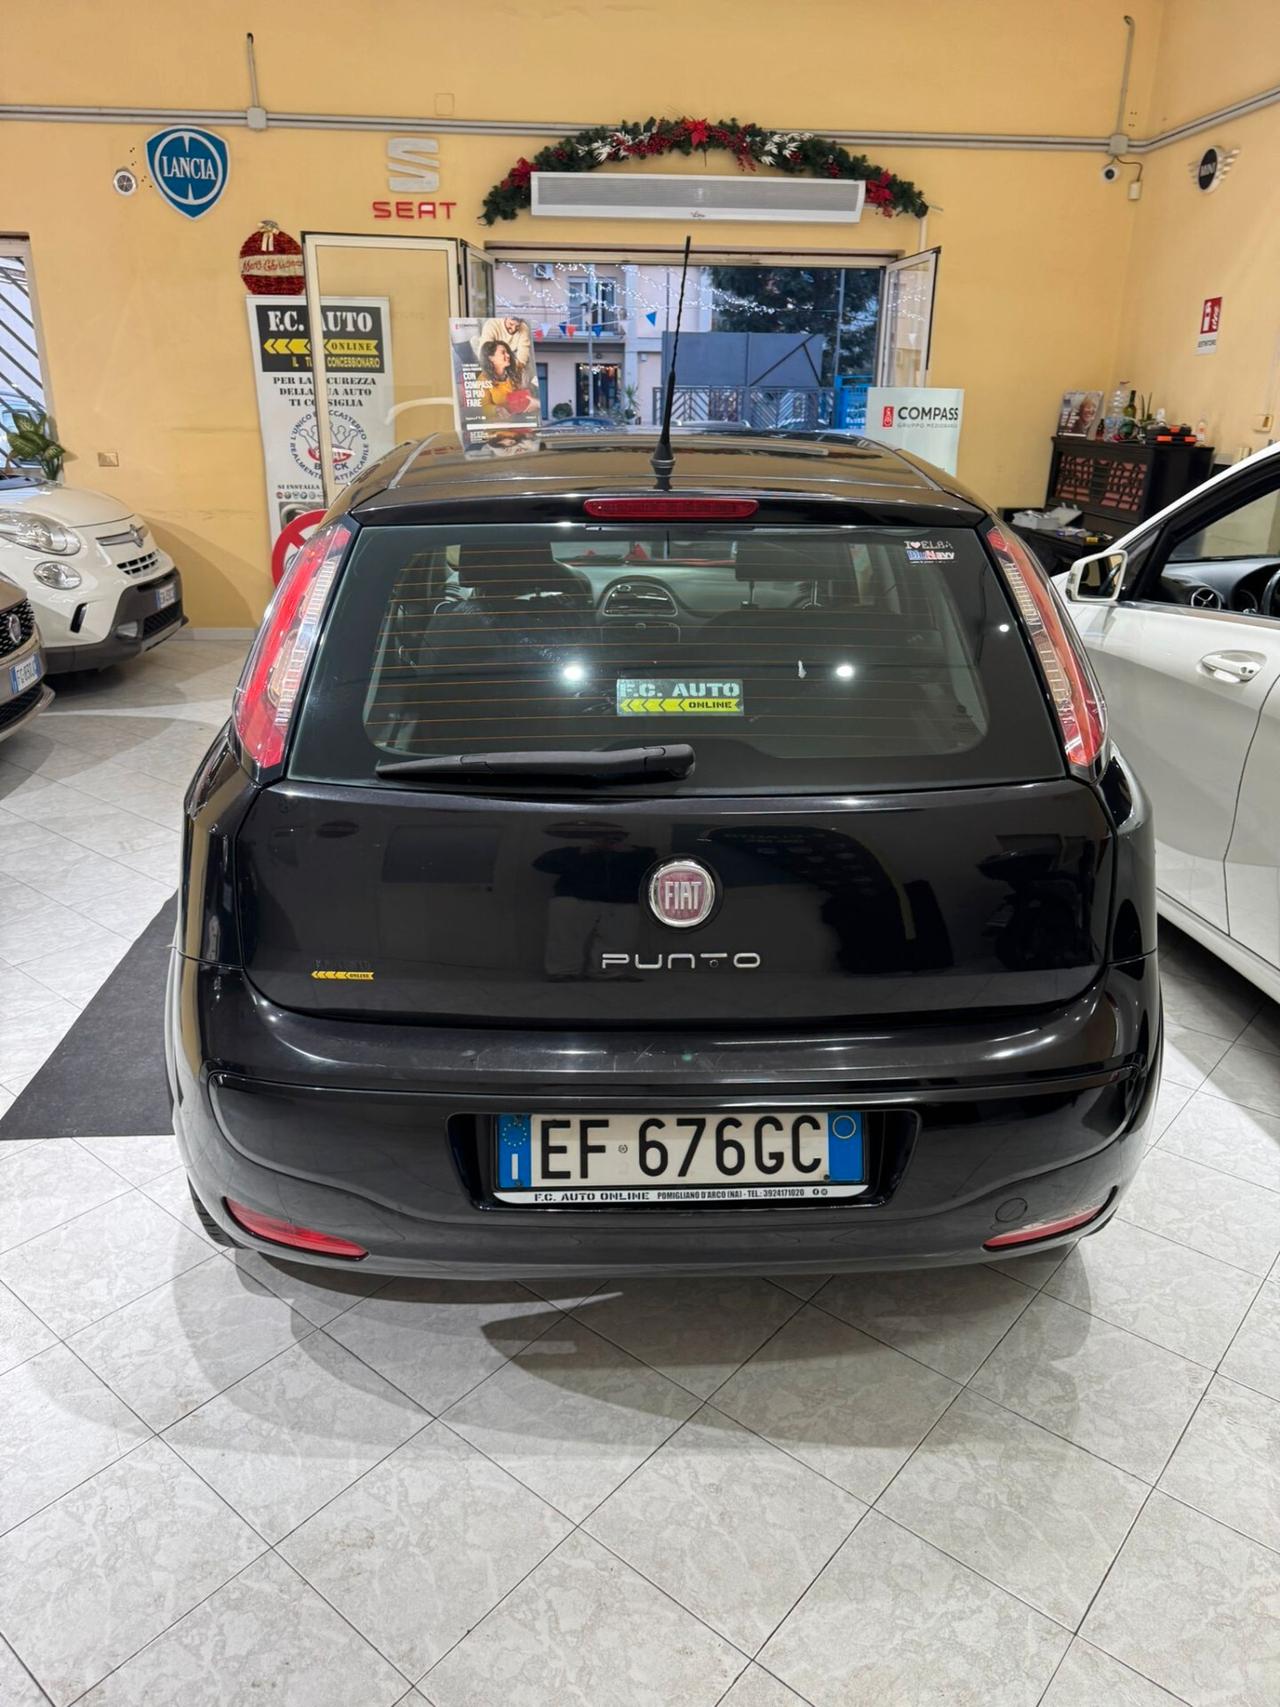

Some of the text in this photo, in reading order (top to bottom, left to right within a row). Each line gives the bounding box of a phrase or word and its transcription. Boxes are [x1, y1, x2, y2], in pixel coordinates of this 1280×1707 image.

[161, 156, 216, 180] LANCIA
[372, 201, 457, 219] SEAT
[267, 310, 373, 332] F.C. UTO
[331, 342, 372, 351] ONLINE
[291, 356, 299, 367] IL
[273, 376, 376, 385] PER LA CUREZZA
[280, 388, 314, 396] DELLA
[342, 388, 372, 396] AUTO
[289, 398, 301, 407] TI
[898, 406, 958, 420] COMPASS
[620, 683, 740, 697] F.C. AUTO
[689, 701, 732, 709] ONLINE
[664, 881, 702, 910] FIAT
[602, 953, 761, 969] PUNTO
[541, 1119, 609, 1179] EF
[639, 1115, 822, 1177] 676GC
[534, 1193, 556, 1202] F.C.
[561, 1192, 596, 1201] AUTO
[600, 1192, 650, 1201] ONLINE
[657, 1191, 700, 1200] POMIGLIANO
[701, 1190, 726, 1199] D'ARCO
